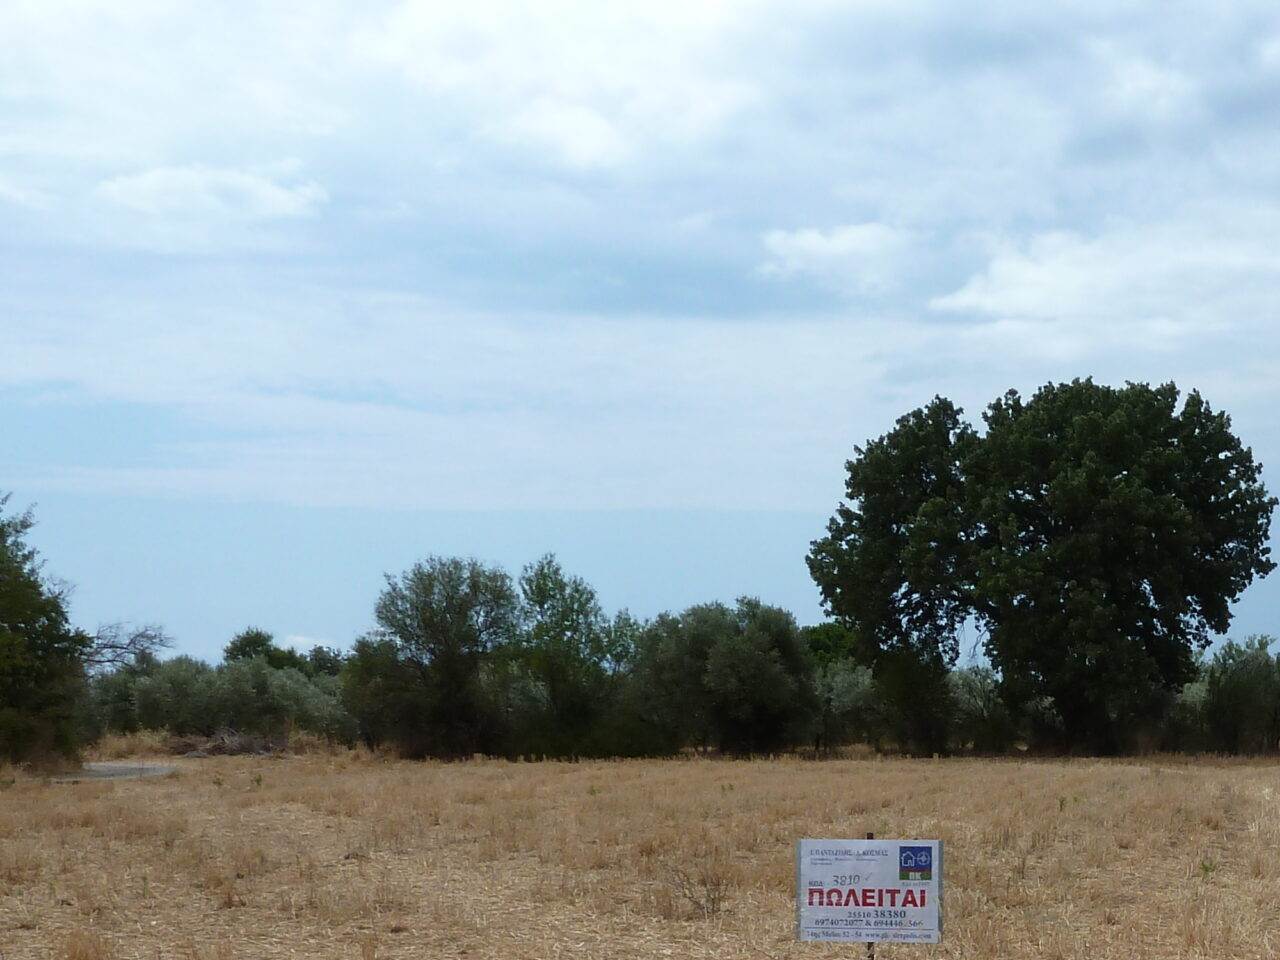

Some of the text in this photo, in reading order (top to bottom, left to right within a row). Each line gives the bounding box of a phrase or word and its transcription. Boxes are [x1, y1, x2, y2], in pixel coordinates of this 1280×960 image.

[832, 874, 861, 886] 3810
[808, 888, 926, 907] ΠΩΛΕΙΤΑΙ
[873, 910, 906, 919] 38380
